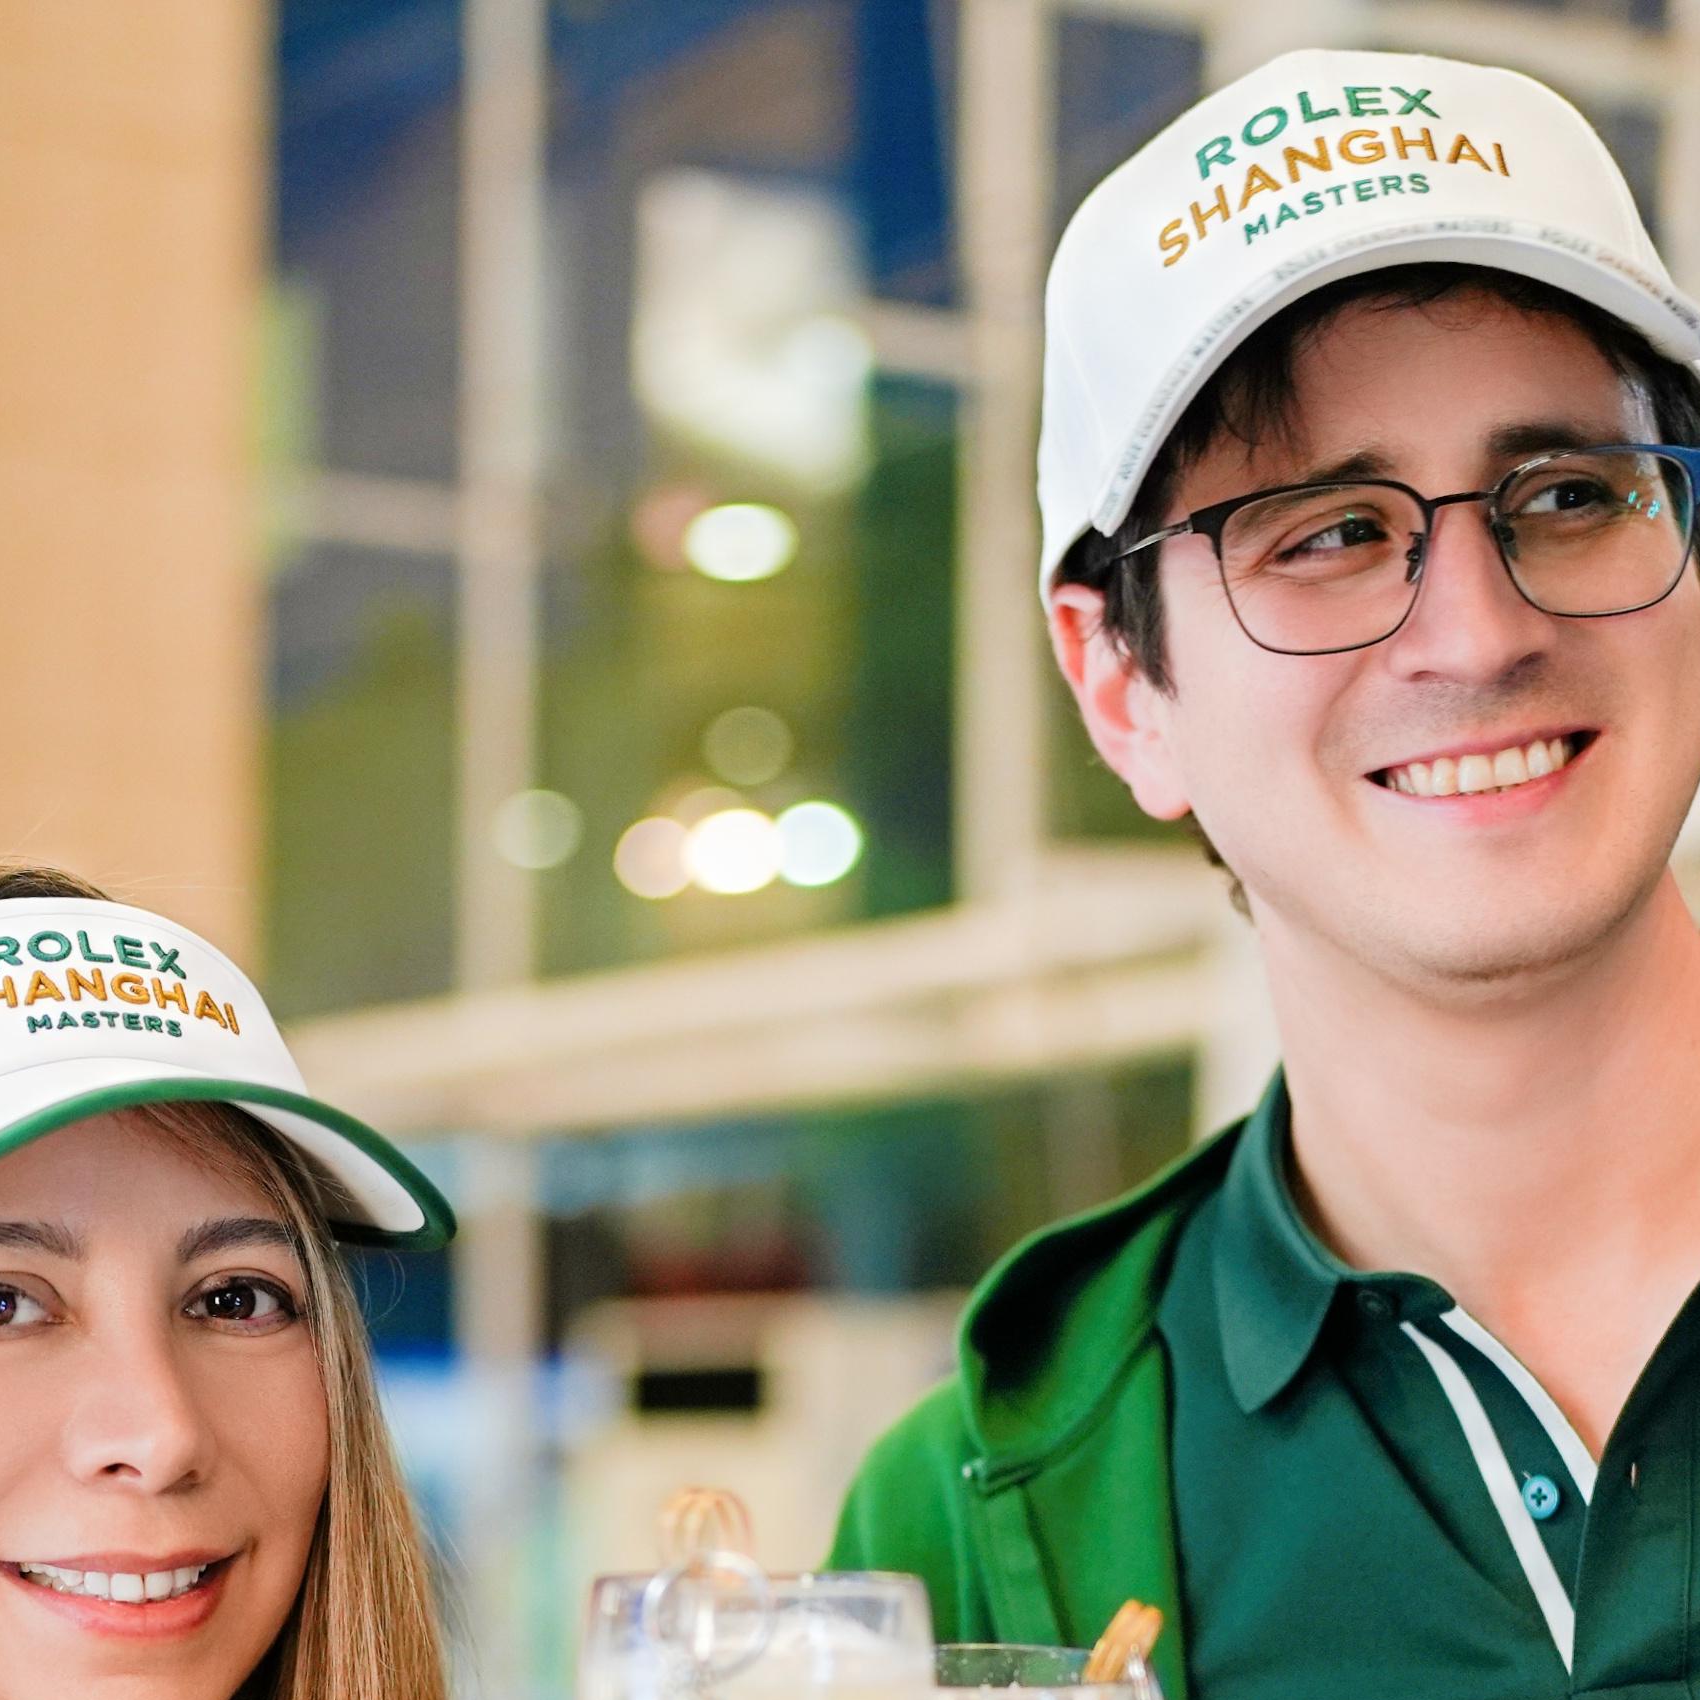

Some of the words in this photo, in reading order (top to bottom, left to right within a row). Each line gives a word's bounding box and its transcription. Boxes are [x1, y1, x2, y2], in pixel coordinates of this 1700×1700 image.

[1195, 85, 1442, 180] ROLEX
[1158, 126, 1511, 268] SHANGHAI
[1243, 173, 1431, 245] MASTERS
[27, 1012, 184, 1037] MASTERS
